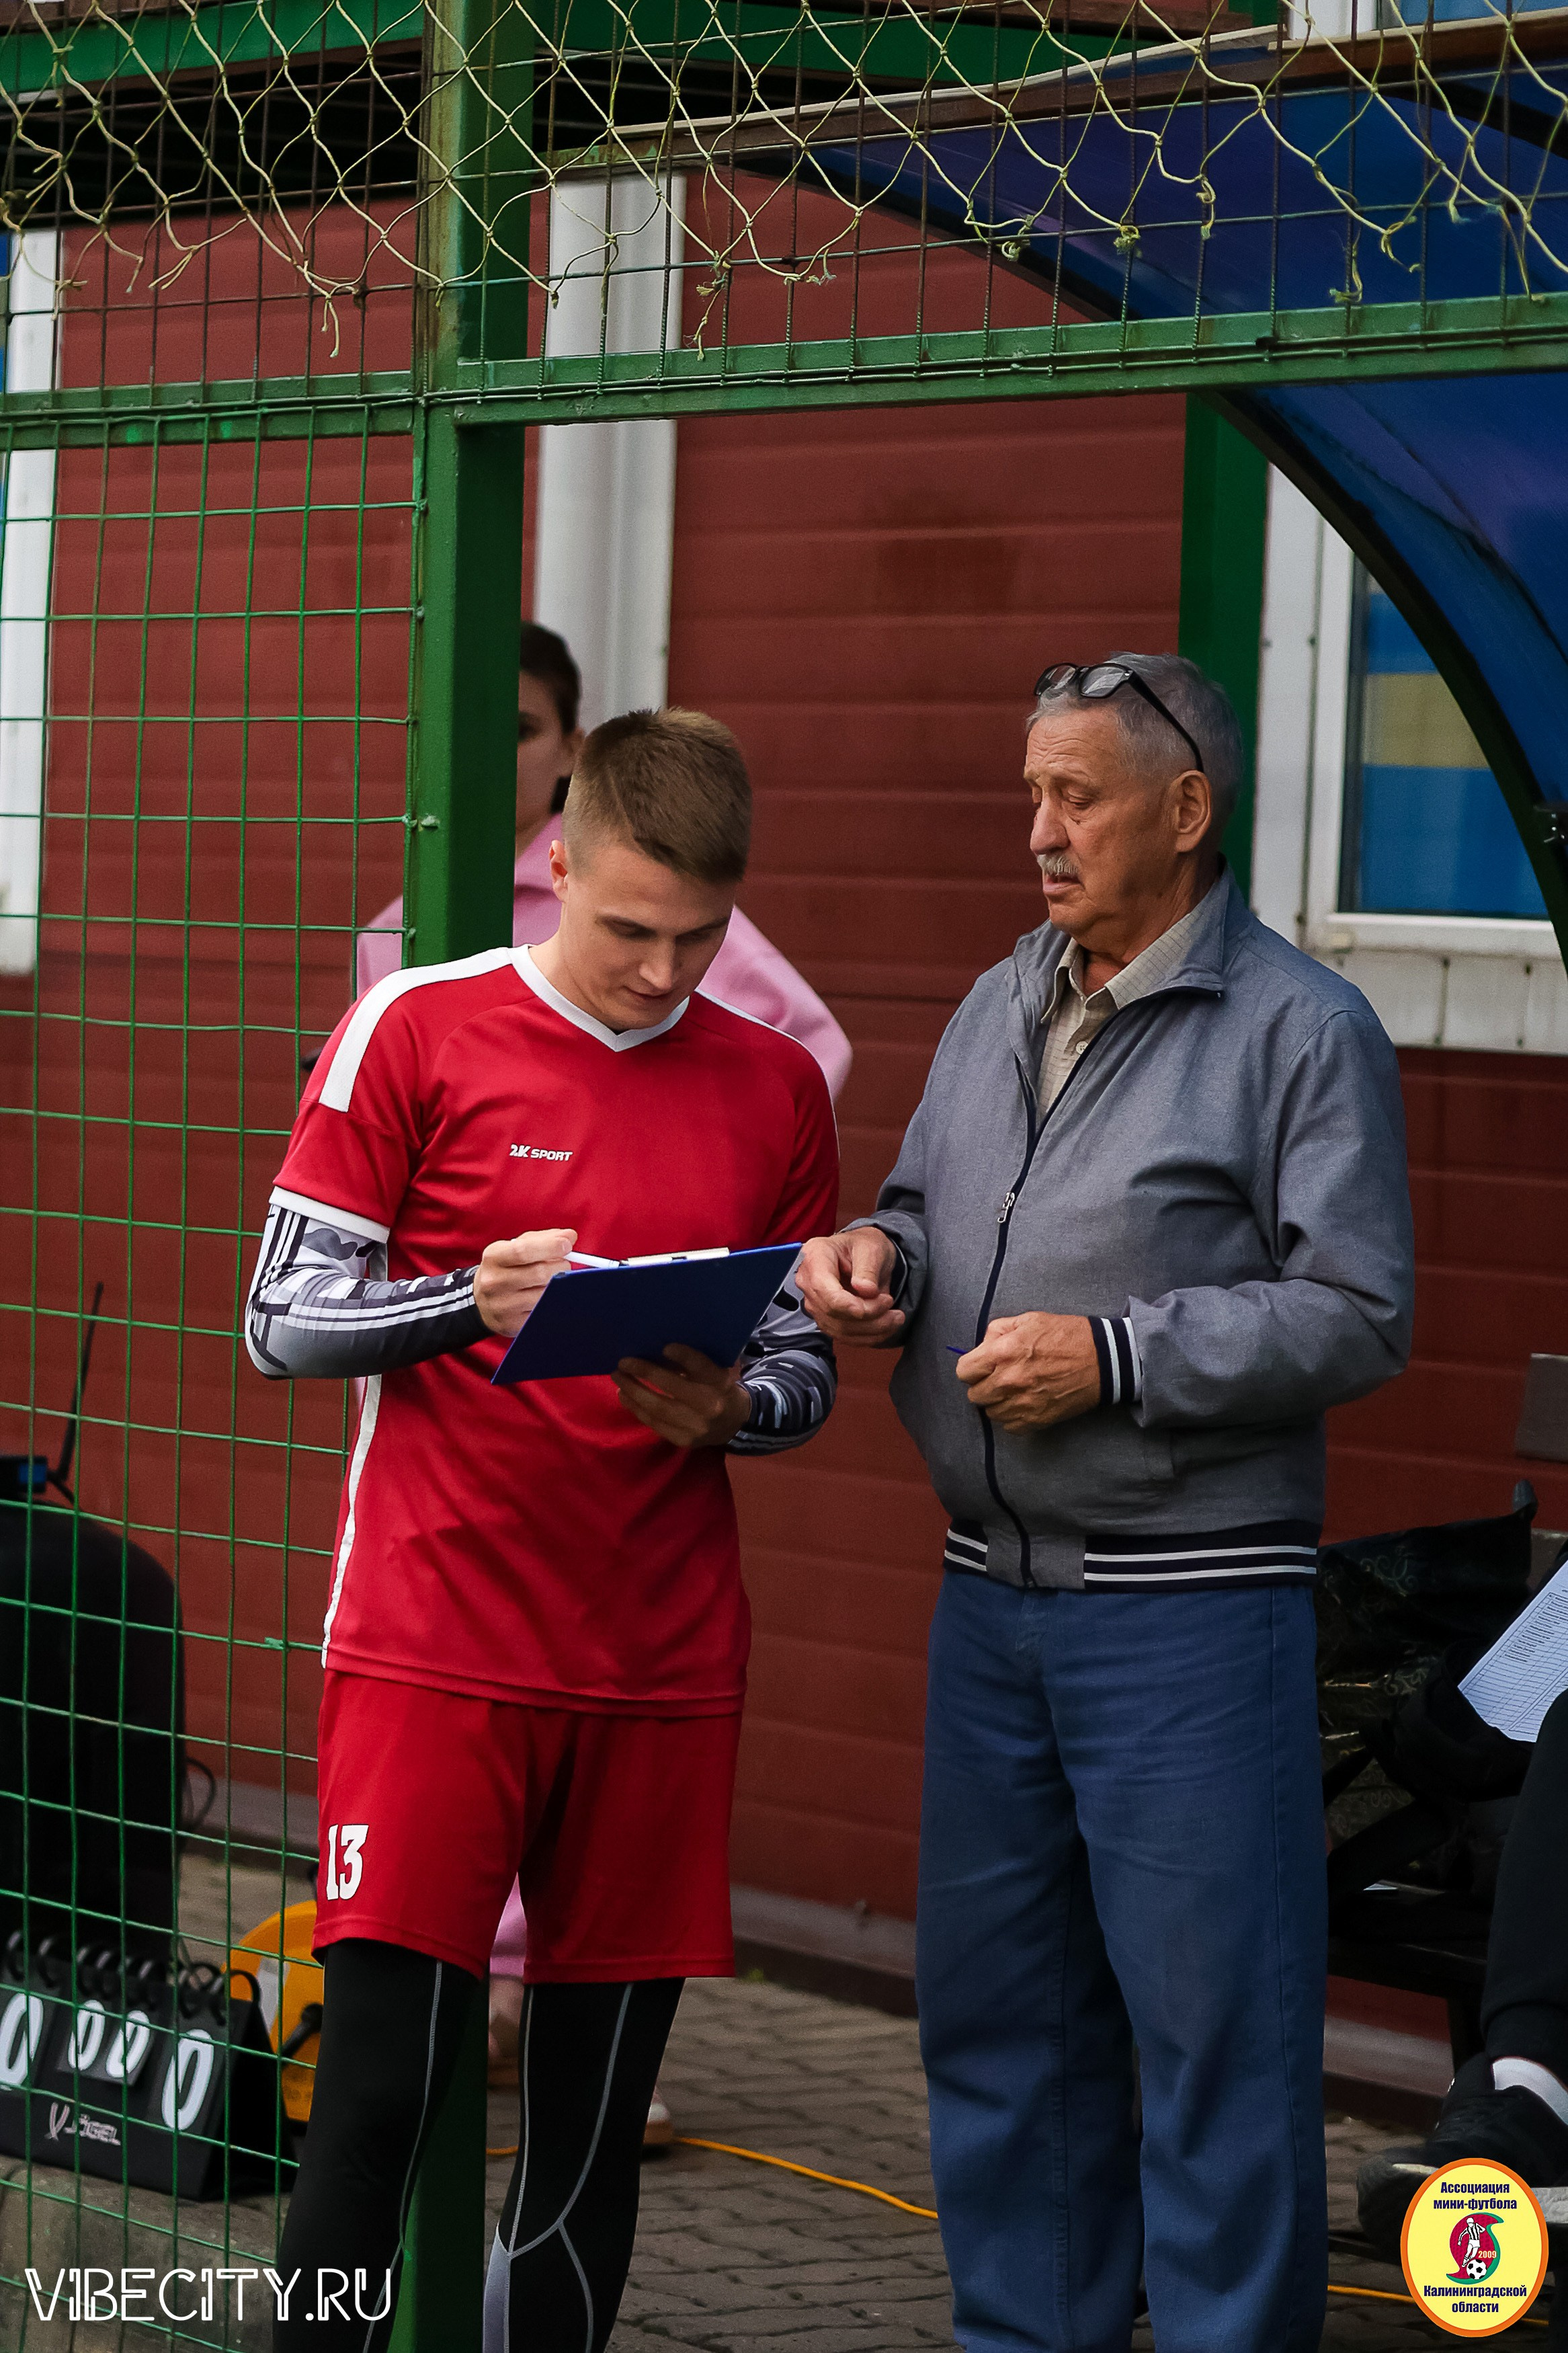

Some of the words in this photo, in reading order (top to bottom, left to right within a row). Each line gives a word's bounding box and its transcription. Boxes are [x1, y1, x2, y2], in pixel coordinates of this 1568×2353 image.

[509, 1144, 531, 1158] 2K
[530, 1148, 573, 1161] SPORT
[327, 1825, 369, 1900] 13
[161, 2028, 214, 2130] 0
